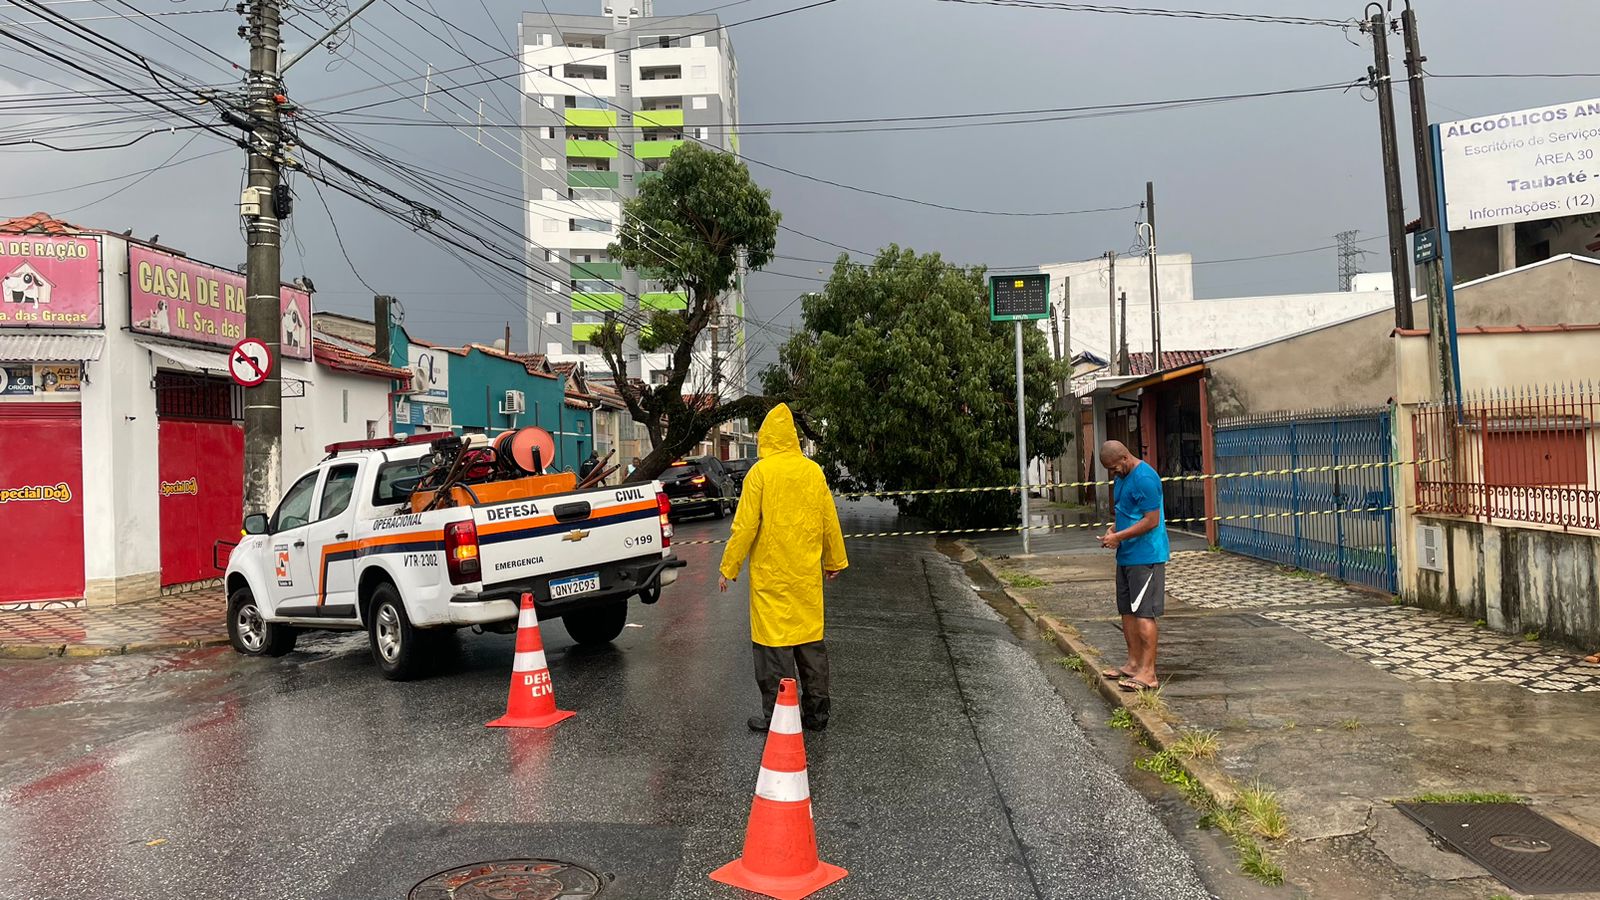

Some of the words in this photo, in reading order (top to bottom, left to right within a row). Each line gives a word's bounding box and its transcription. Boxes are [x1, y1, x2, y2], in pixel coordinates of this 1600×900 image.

[1447, 107, 1568, 138] ALCOÓLICOS
[1464, 140, 1525, 156] Escritório
[1527, 135, 1545, 147] de
[1535, 152, 1575, 167] ÁREA
[1577, 149, 1594, 161] 30
[1507, 170, 1587, 192] Taubaté
[1469, 199, 1561, 220] Informações:
[1566, 193, 1596, 210] (12)
[9, 241, 31, 256] DE
[34, 241, 88, 261] RAÇÃO
[138, 260, 192, 302] CASA
[195, 275, 220, 309] DE
[15, 310, 38, 321] das
[42, 310, 88, 324] Graças
[177, 307, 190, 329] N.
[193, 311, 218, 336] Sra.
[221, 317, 240, 338] das
[0, 487, 41, 501] pecial
[43, 483, 70, 501] Dog
[161, 482, 184, 496] Special
[185, 478, 198, 495] Dog
[615, 488, 645, 502] CIVIL
[487, 503, 540, 521] DEFESA
[373, 514, 422, 530] OPERACIONAL
[634, 535, 653, 546] 199
[404, 554, 438, 567] VTR-2302
[495, 556, 544, 571] EMERGENCIA
[555, 579, 596, 597] QNY2C93
